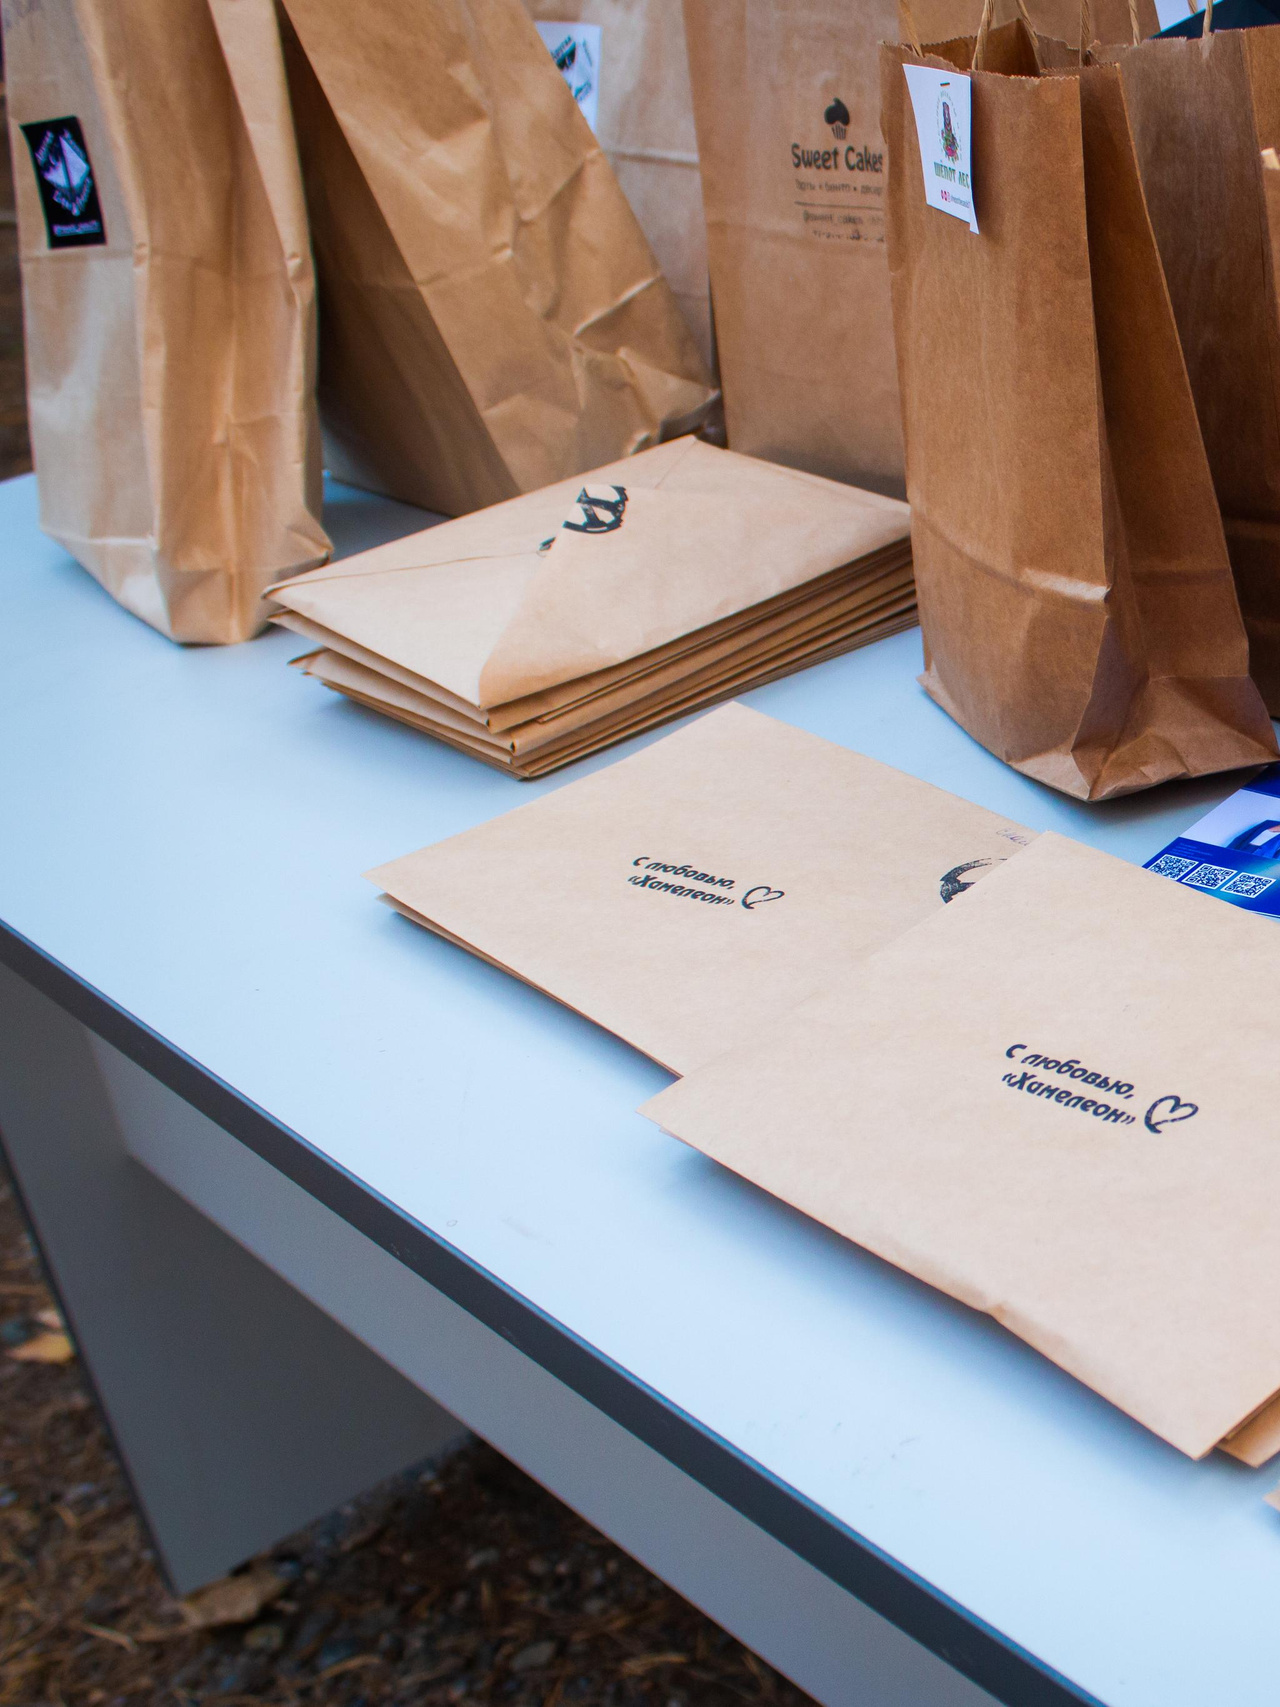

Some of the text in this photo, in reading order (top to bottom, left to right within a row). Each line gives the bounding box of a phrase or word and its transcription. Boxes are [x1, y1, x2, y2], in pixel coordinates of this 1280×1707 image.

[791, 142, 840, 170] Sweet
[627, 874, 735, 906] «Хамелеон»
[632, 856, 736, 890] С любовью,
[1005, 1043, 1135, 1099] С любовью,
[1001, 1071, 1136, 1125] «Хамелеон»
